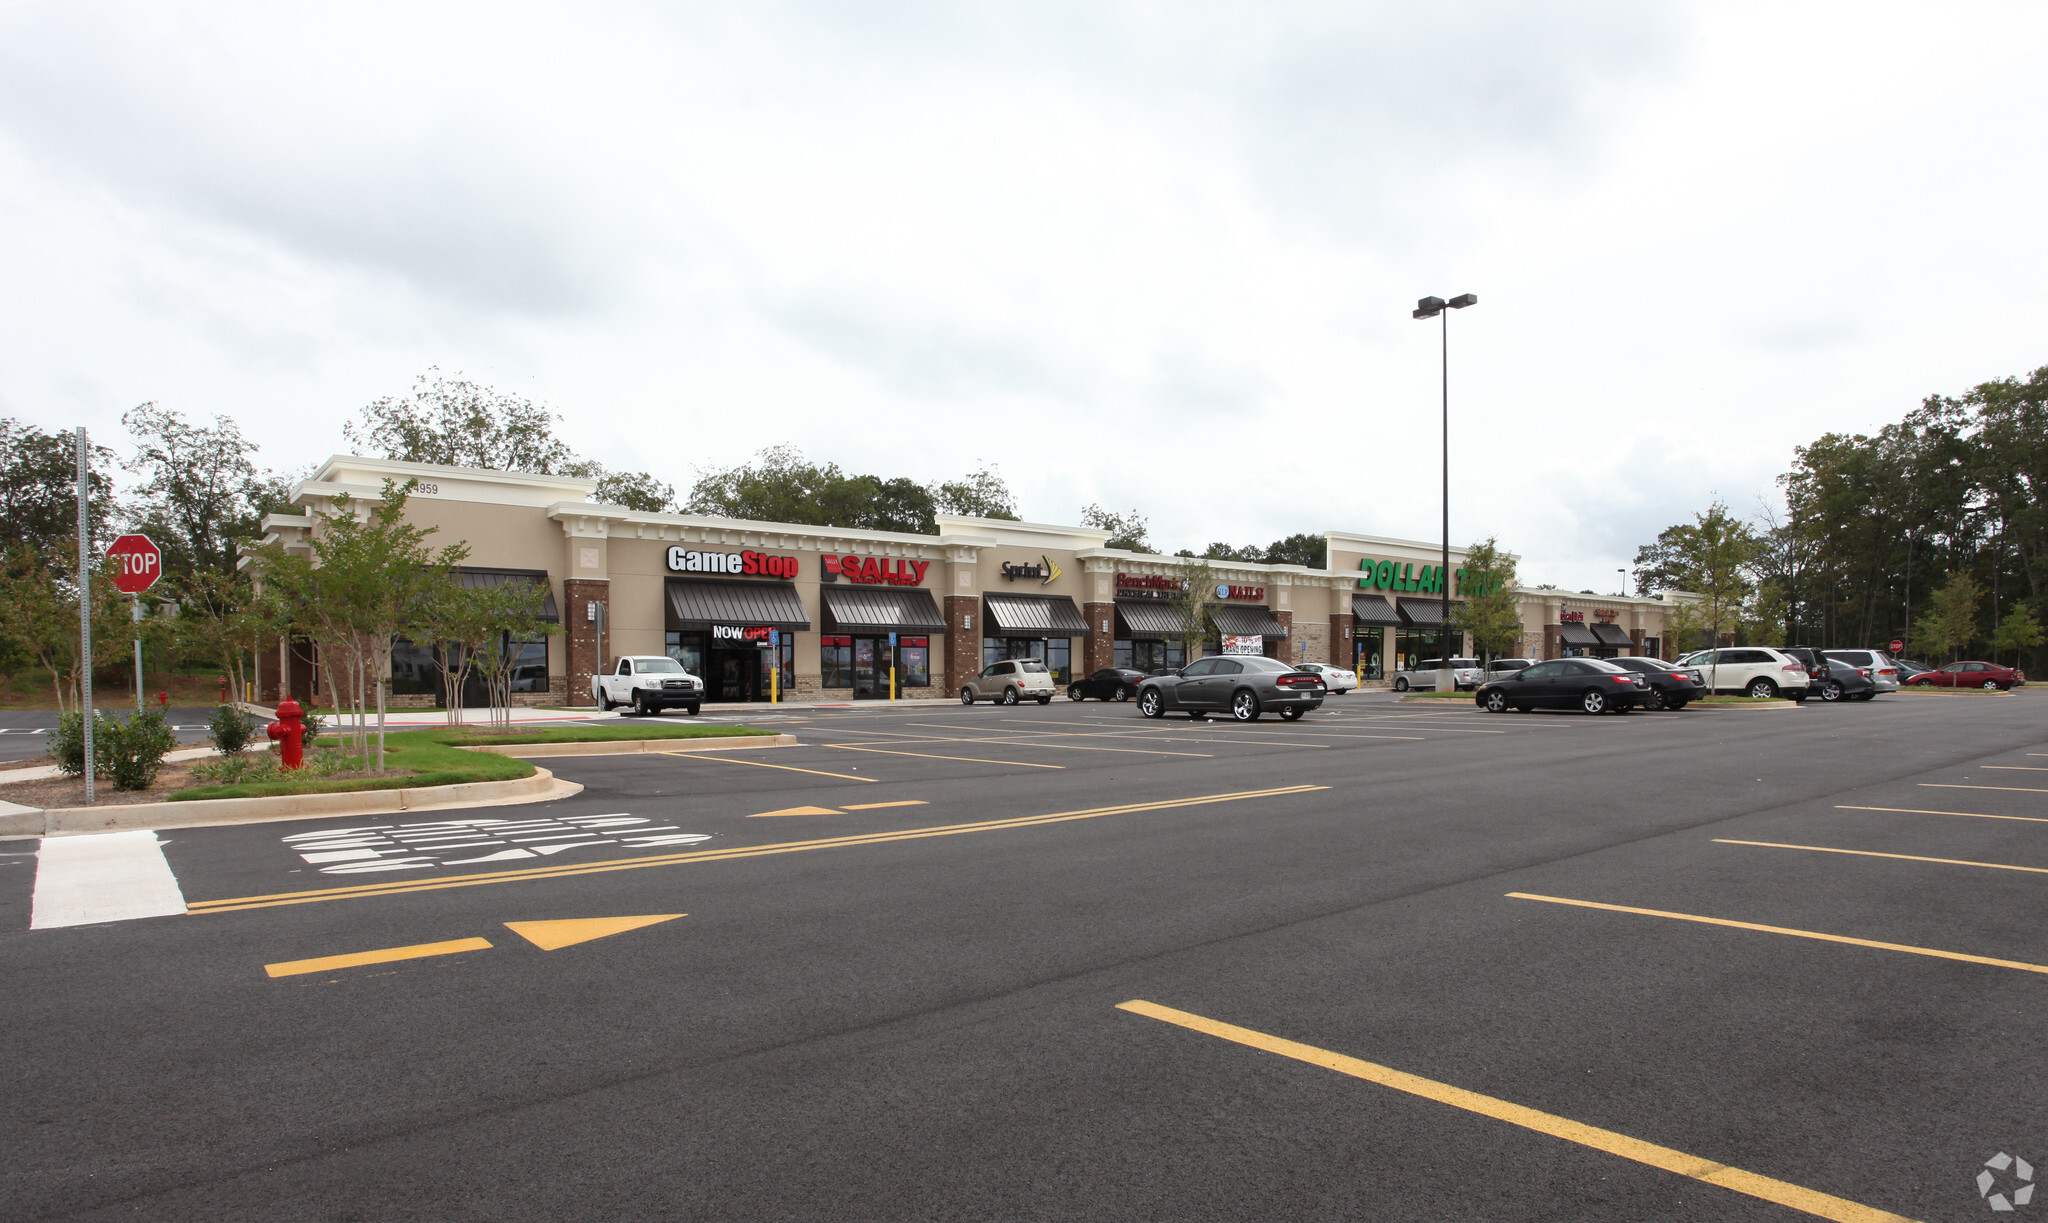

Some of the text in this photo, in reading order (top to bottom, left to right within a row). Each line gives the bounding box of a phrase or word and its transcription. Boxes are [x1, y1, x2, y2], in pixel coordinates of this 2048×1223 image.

[413, 483, 438, 495] 4959
[667, 545, 799, 578] GameStop
[841, 555, 930, 582] SALLY
[1000, 561, 1042, 582] Sprint
[850, 577, 885, 585] BEAUTY
[1117, 588, 1157, 599] PHYSICAL
[1228, 585, 1265, 601] NAILS
[713, 625, 744, 640] NOW
[1240, 645, 1262, 654] OPENING
